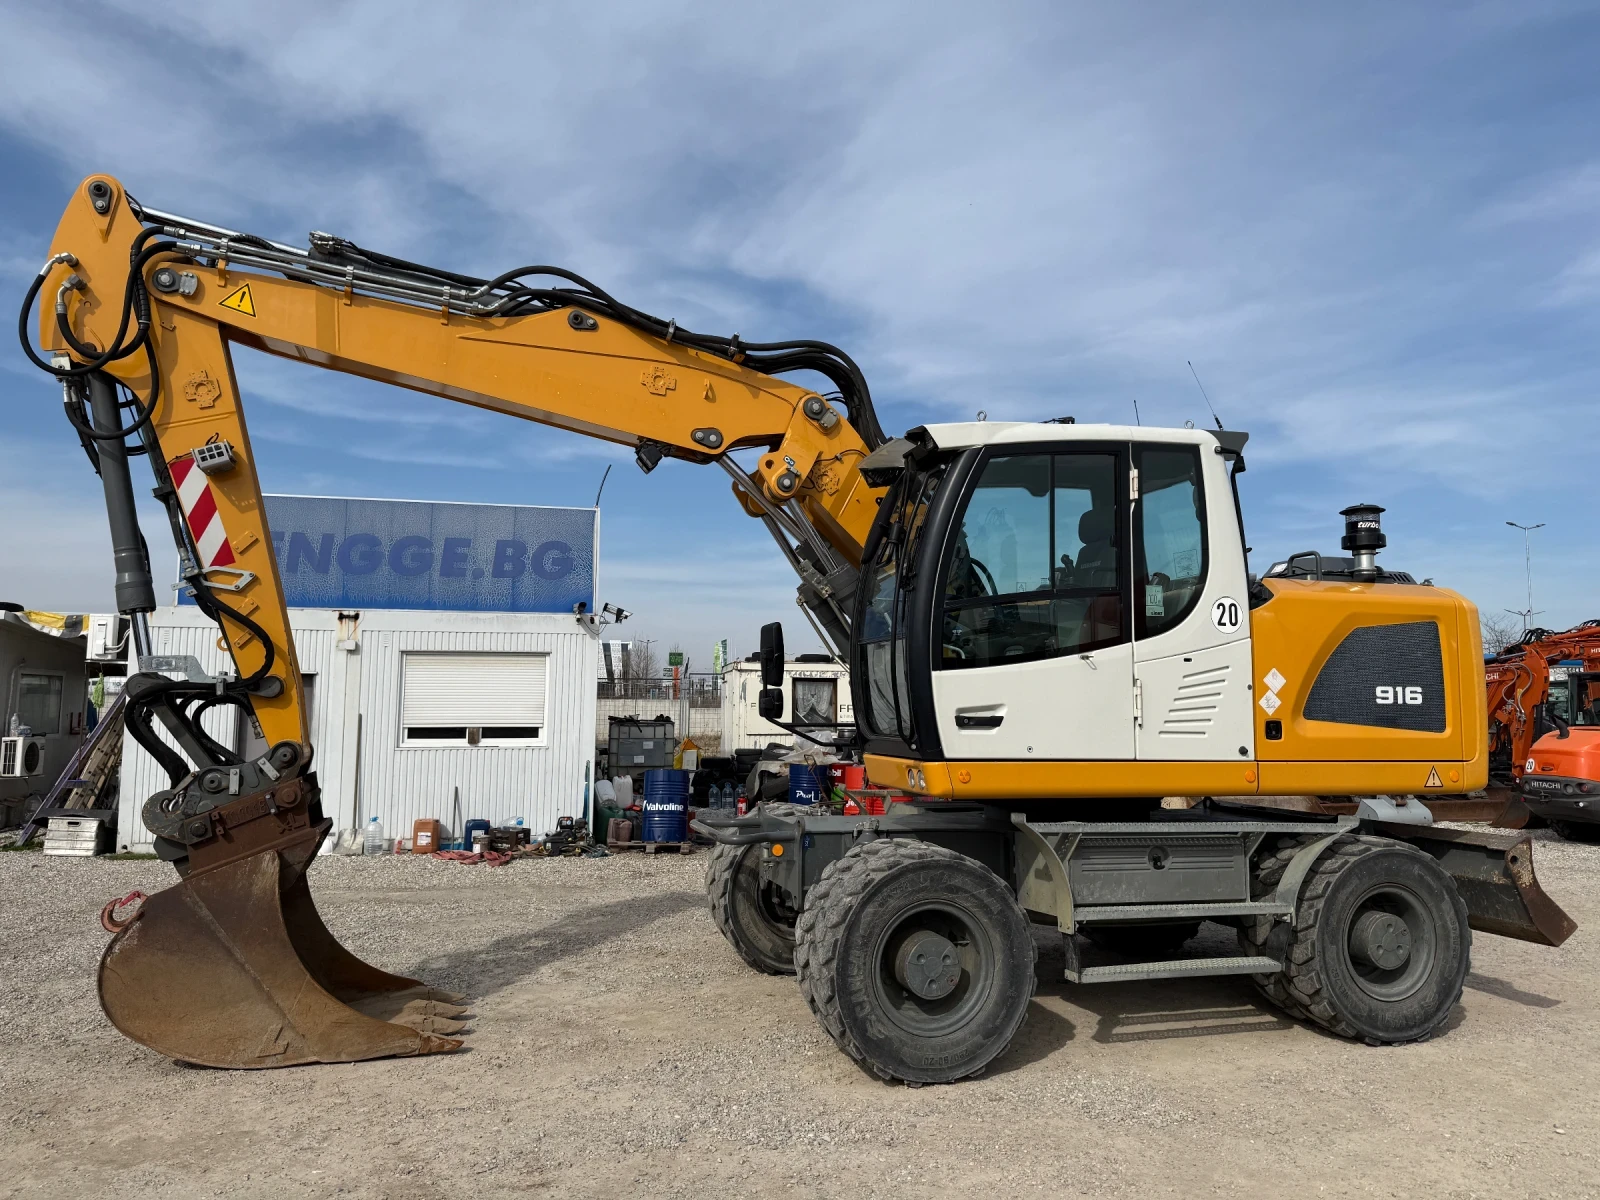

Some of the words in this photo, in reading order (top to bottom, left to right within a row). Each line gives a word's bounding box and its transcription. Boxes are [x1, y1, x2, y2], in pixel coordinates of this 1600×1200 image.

[1216, 602, 1238, 627] 20
[1375, 686, 1423, 704] 916
[1526, 761, 1533, 770] 20
[1531, 781, 1561, 789] HITACHI
[646, 802, 684, 811] Valvoline
